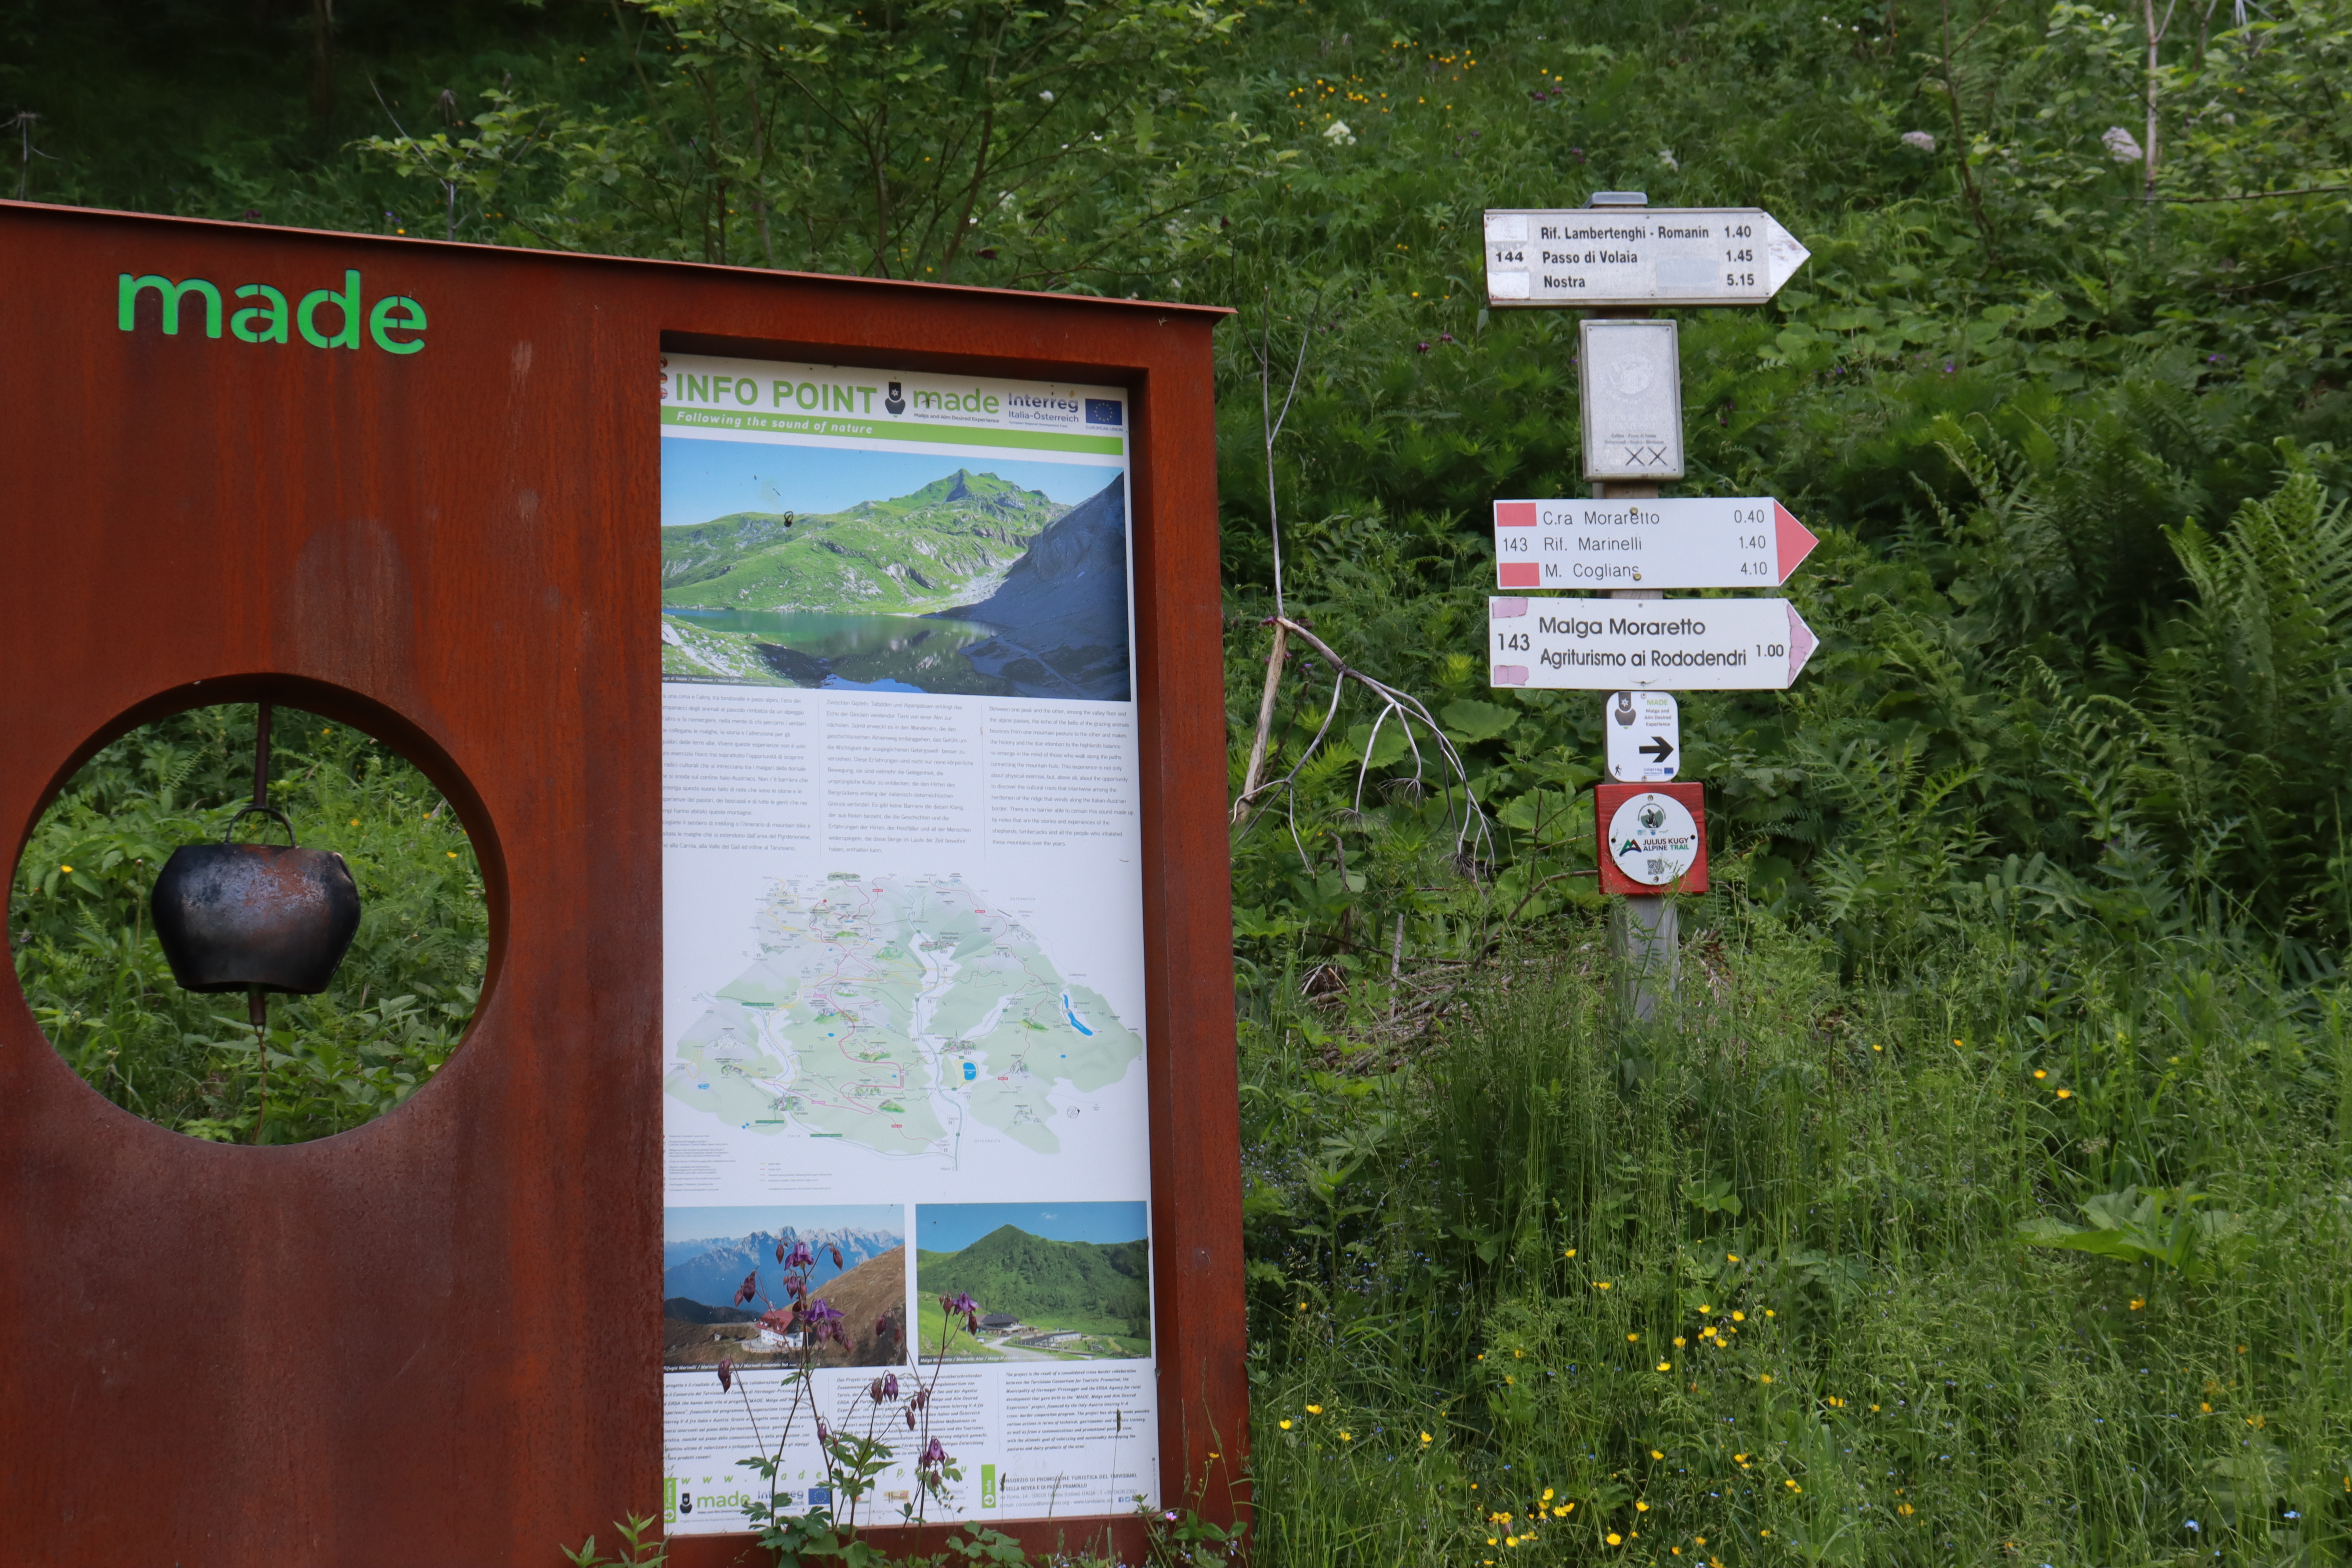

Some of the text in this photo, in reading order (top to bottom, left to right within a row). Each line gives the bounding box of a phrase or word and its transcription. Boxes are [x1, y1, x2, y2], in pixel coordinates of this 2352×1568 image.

[1541, 227, 1560, 239] Rif.
[1565, 227, 1646, 241] Lambertenghi
[1658, 226, 1709, 238] Romanin
[1724, 225, 1751, 238] 1.40
[1496, 249, 1753, 264] 144 Passo di Volaia 1.45
[1544, 274, 1754, 288] Nostra 5.15
[119, 269, 427, 354] made
[676, 373, 877, 414] INFO POINT
[913, 388, 999, 414] made
[1009, 392, 1078, 412] Interreg
[677, 411, 873, 434] Following the sound of nature
[1009, 410, 1079, 422] Italia-Österreich
[1543, 510, 1764, 525] C.ra Moraretto 0.40
[1503, 535, 1766, 552] 143 Rif. Marinelli 1.40
[1546, 562, 1767, 580] M. Coglians 4.10
[1539, 617, 1706, 638] Malga Moraretto
[1498, 633, 1530, 651] 143
[1540, 644, 1784, 669] Agriturismo ai Rododendri 1.00
[697, 1491, 750, 1508] made
[758, 1490, 804, 1499] Integ
